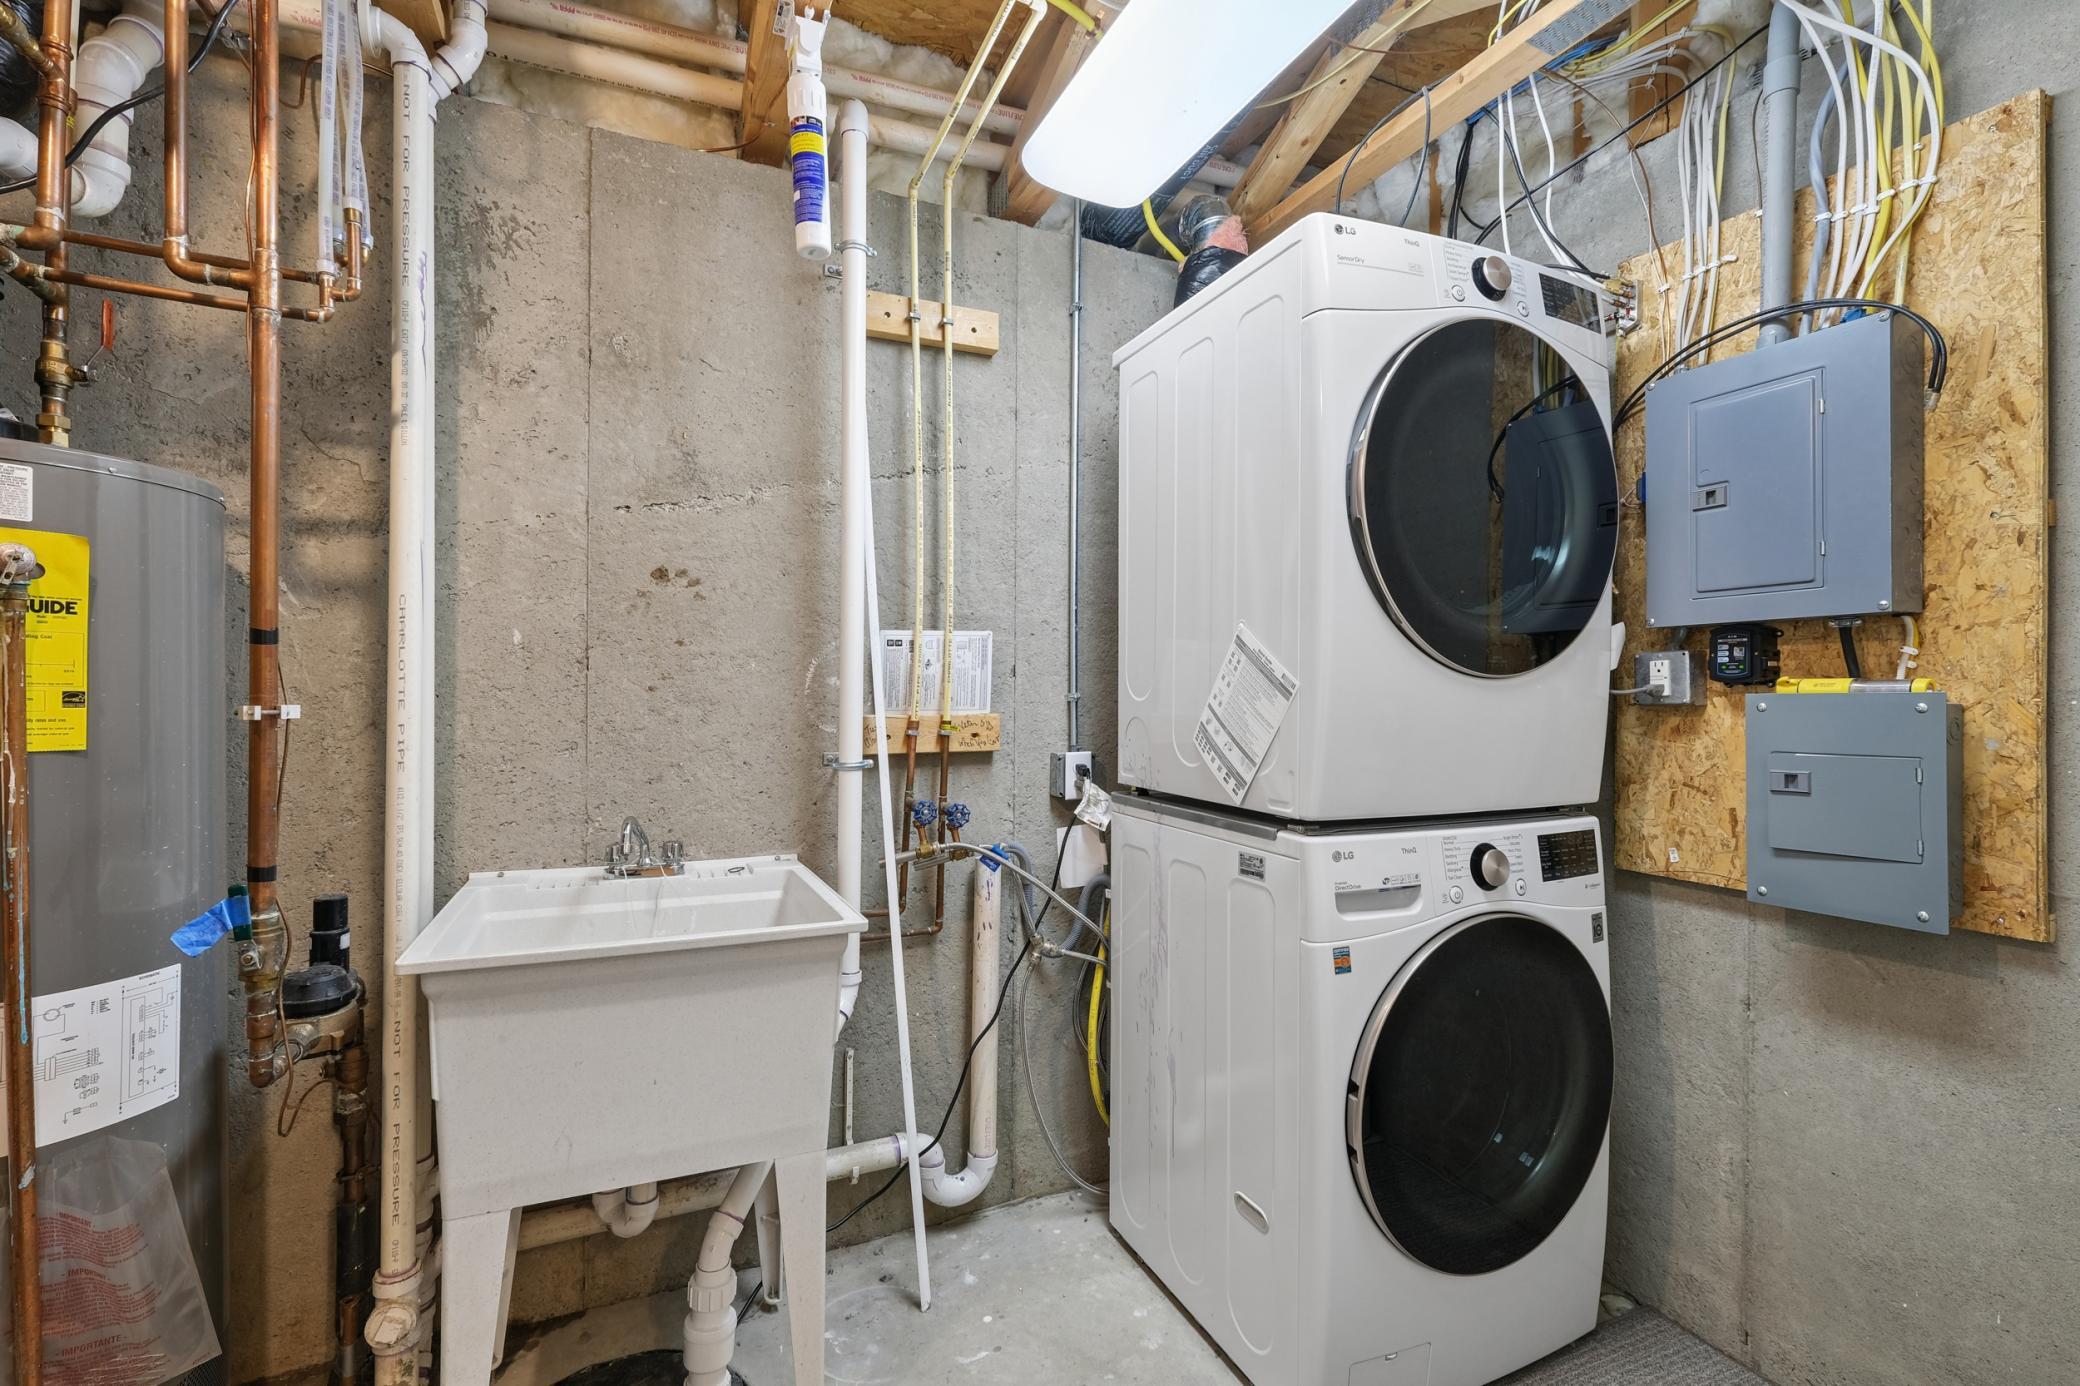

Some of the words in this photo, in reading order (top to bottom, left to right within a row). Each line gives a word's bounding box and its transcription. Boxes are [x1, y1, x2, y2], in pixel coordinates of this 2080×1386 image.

[402, 84, 410, 121] NOT
[402, 135, 410, 173] FOR
[401, 186, 410, 288] PRESSURE
[397, 594, 407, 711] CHARLOTTE
[396, 723, 406, 773] PIPE
[1401, 846, 1417, 854] ThinQ
[393, 1020, 401, 1058] NOT
[392, 1071, 401, 1111] FOR
[391, 1122, 401, 1226] PRESSURE
[62, 1333, 122, 1357] IMPORTANTE
